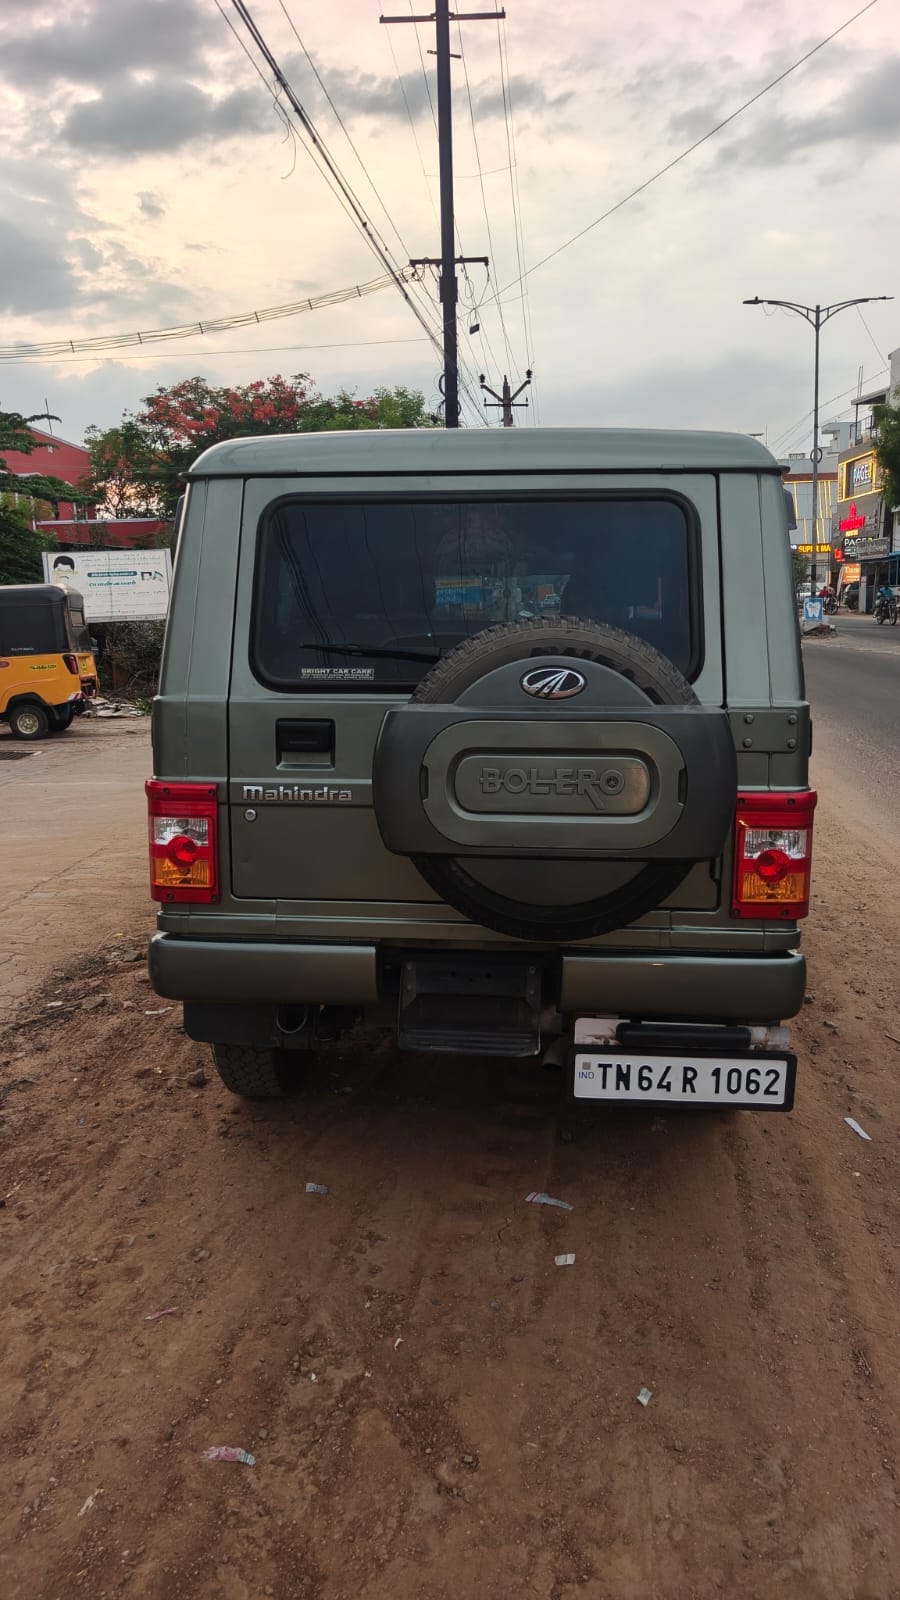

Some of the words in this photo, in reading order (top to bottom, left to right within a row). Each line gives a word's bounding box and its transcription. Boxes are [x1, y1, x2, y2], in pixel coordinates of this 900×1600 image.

[243, 785, 352, 801] Mahindra
[479, 767, 625, 810] BOLERO
[578, 1071, 595, 1080] IND
[711, 1067, 780, 1096] 1062
